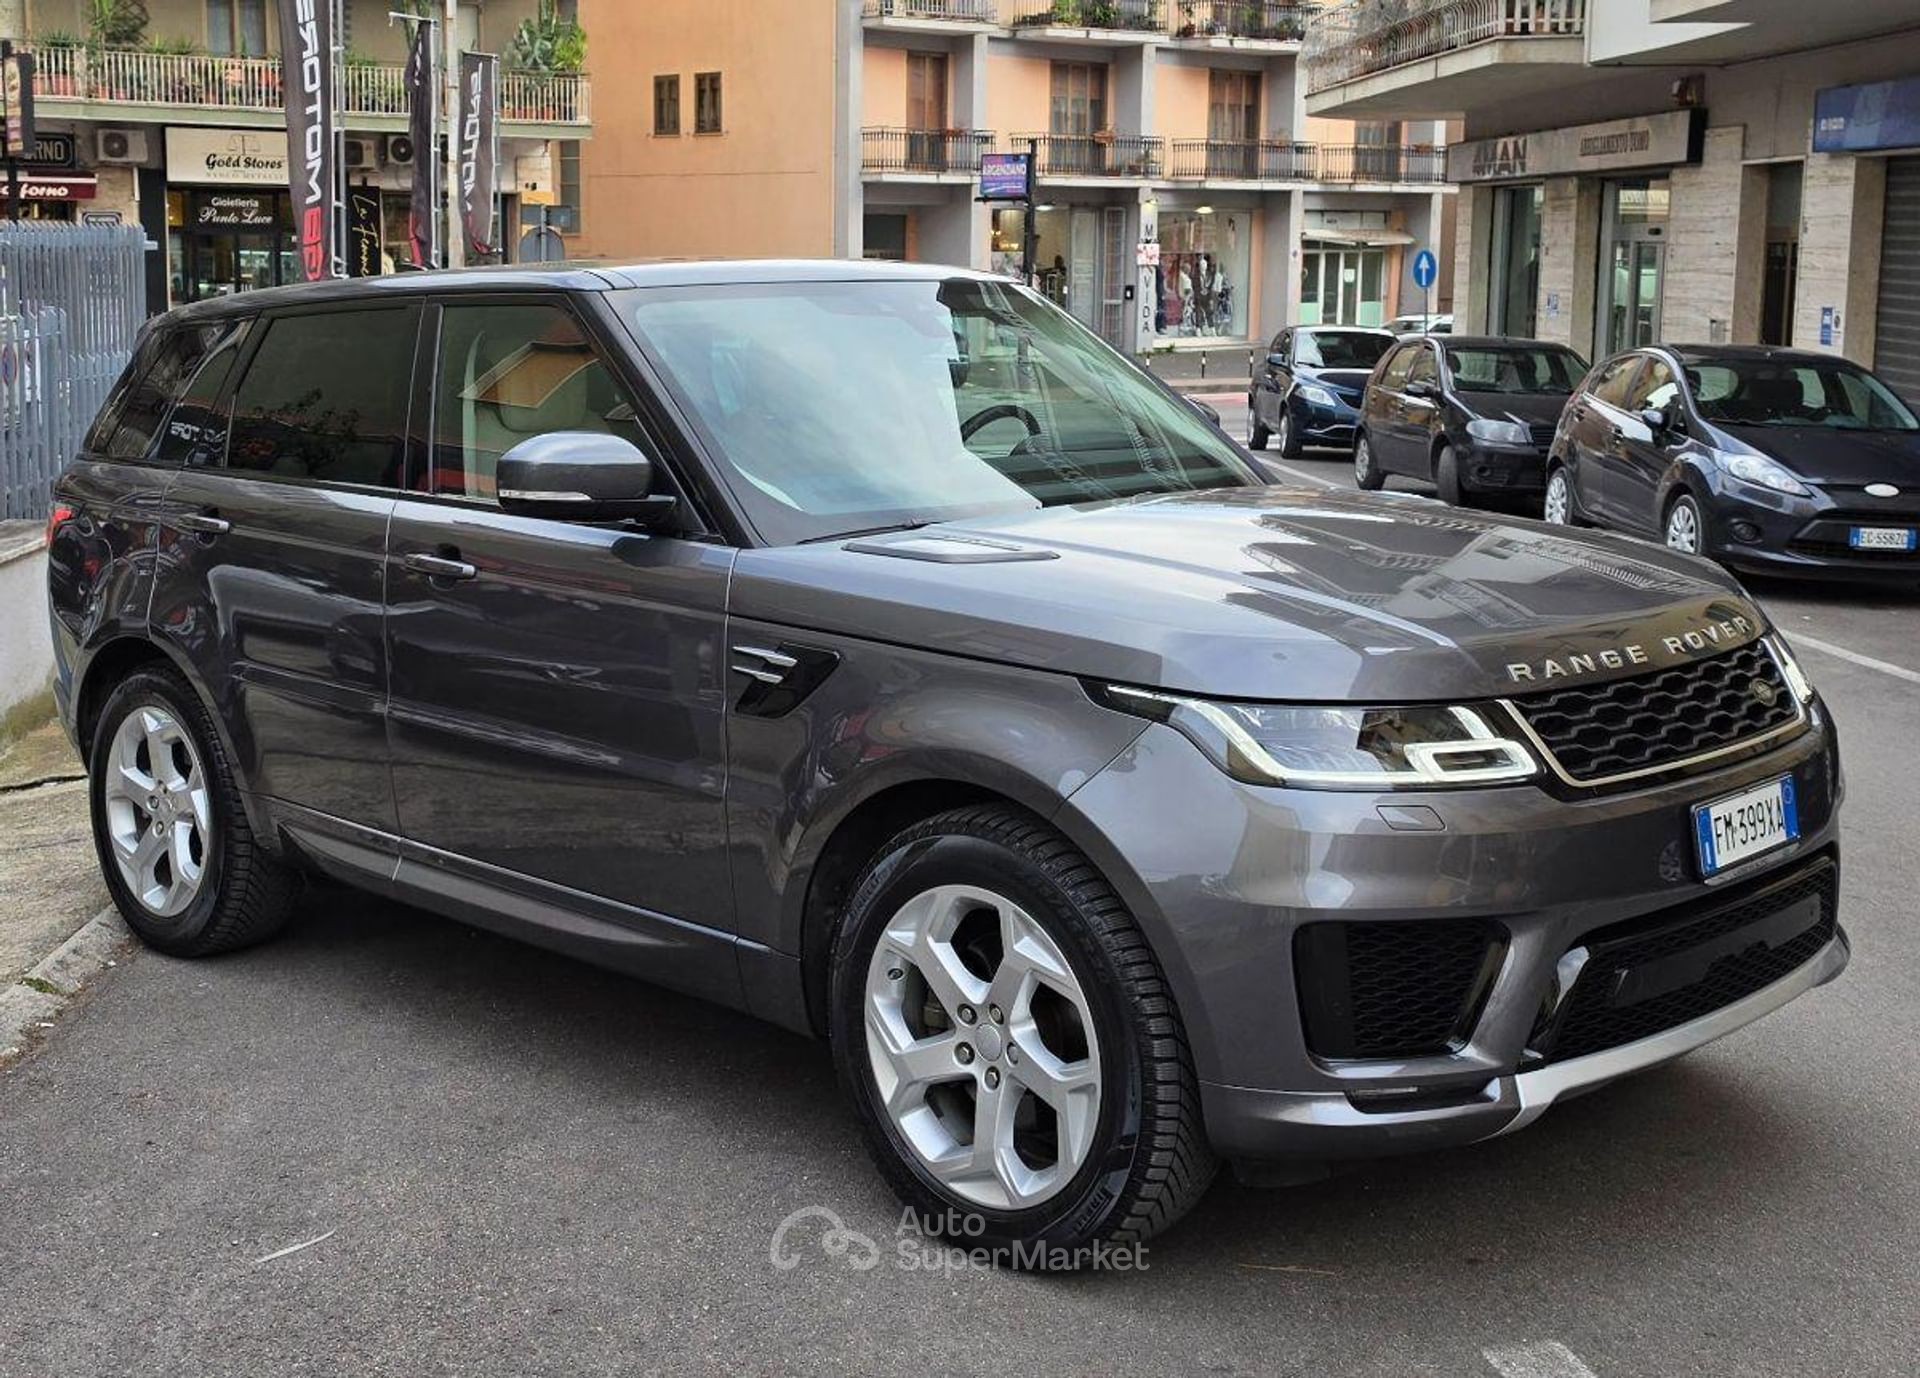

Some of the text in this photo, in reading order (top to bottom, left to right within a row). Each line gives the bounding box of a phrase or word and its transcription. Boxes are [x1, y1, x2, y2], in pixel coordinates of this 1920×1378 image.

[205, 153, 283, 170] Gold Stores
[211, 197, 259, 208] Gioielleria
[199, 207, 273, 224] Punto Luce
[1506, 616, 1751, 682] RANGE ROVER
